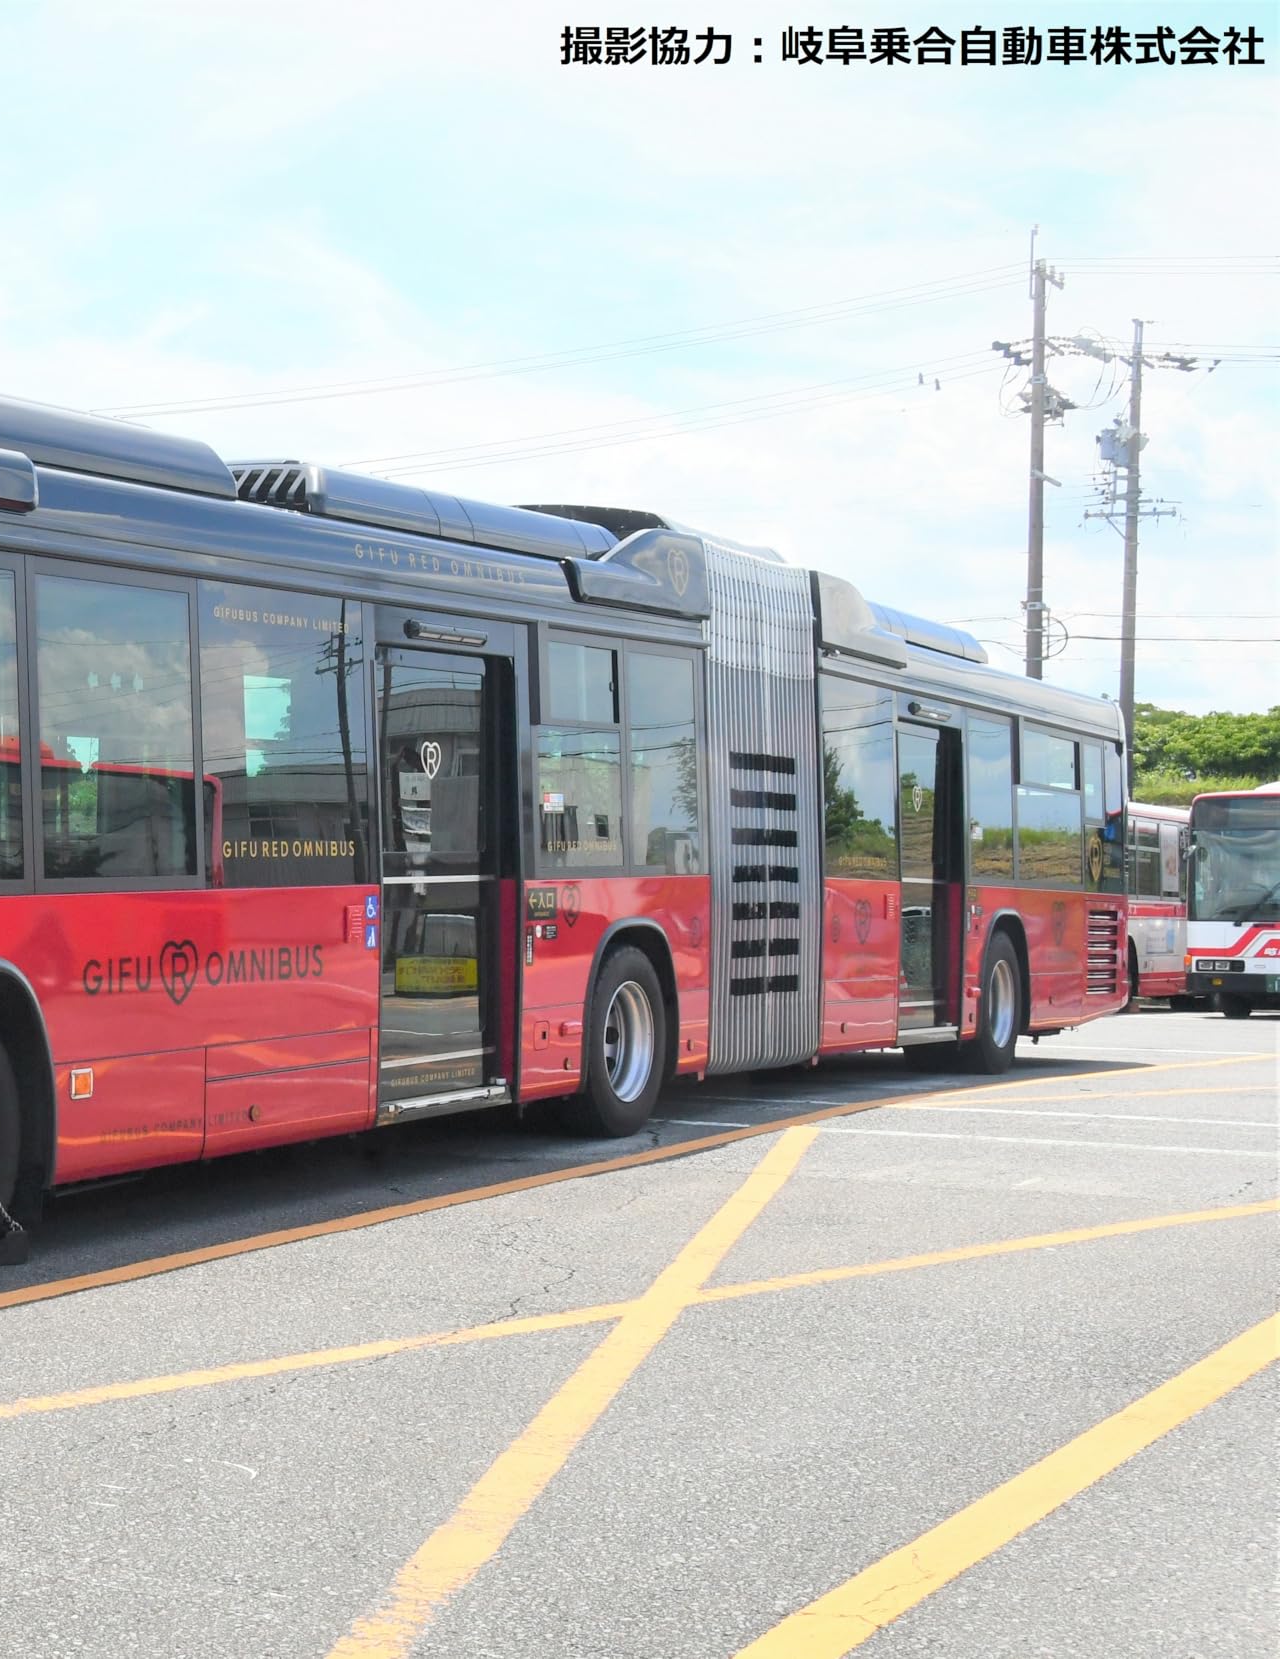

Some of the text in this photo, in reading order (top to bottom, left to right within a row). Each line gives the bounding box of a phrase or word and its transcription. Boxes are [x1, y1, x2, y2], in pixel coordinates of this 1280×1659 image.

[354, 543, 525, 584] GIFU RED OMNIBUS
[213, 606, 350, 634] GIFUBUS COMPANY LIMITED
[222, 840, 356, 858] GIFU RED OMNIBUS
[537, 892, 554, 910] 入口
[83, 956, 152, 995] GIFU
[205, 944, 324, 986] OMNIBUS
[421, 1072, 449, 1083] COMPANY
[154, 1118, 203, 1134] COMPANY
